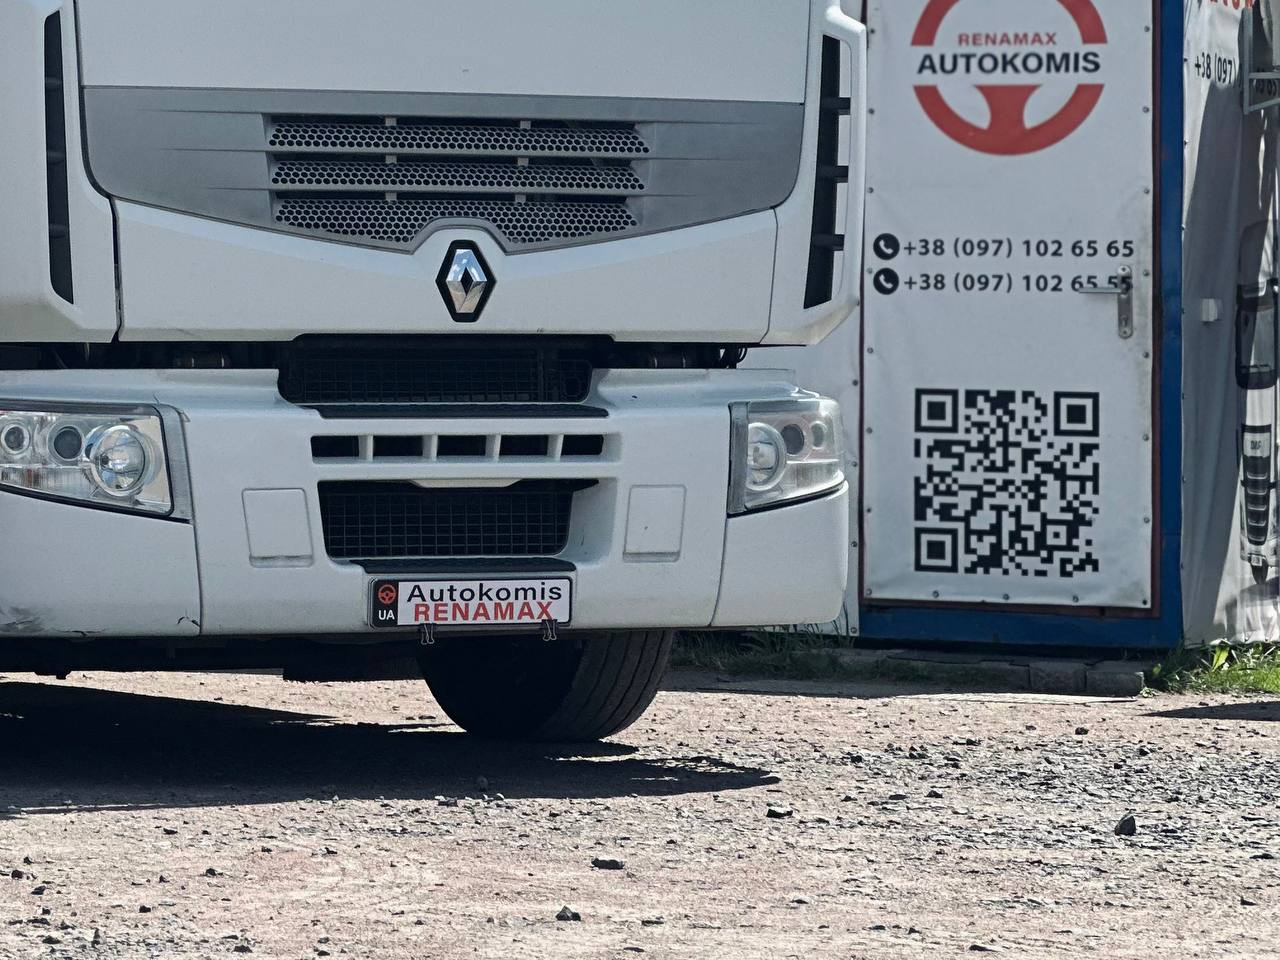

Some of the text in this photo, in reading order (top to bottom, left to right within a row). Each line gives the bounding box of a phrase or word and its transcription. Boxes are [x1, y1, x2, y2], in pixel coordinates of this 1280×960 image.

[957, 32, 1058, 47] RENAMAX
[917, 51, 1101, 75] AUTOKOMIS
[1195, 52, 1212, 80] +38
[904, 237, 1134, 258] +38 (097) 102 65 65
[904, 273, 945, 292] +38
[954, 272, 1013, 293] (097)
[1022, 274, 1063, 292] 102
[1071, 274, 1098, 292] 65
[407, 582, 562, 602] Autokomis
[378, 610, 395, 621] UA
[414, 601, 553, 622] RENAMAX
